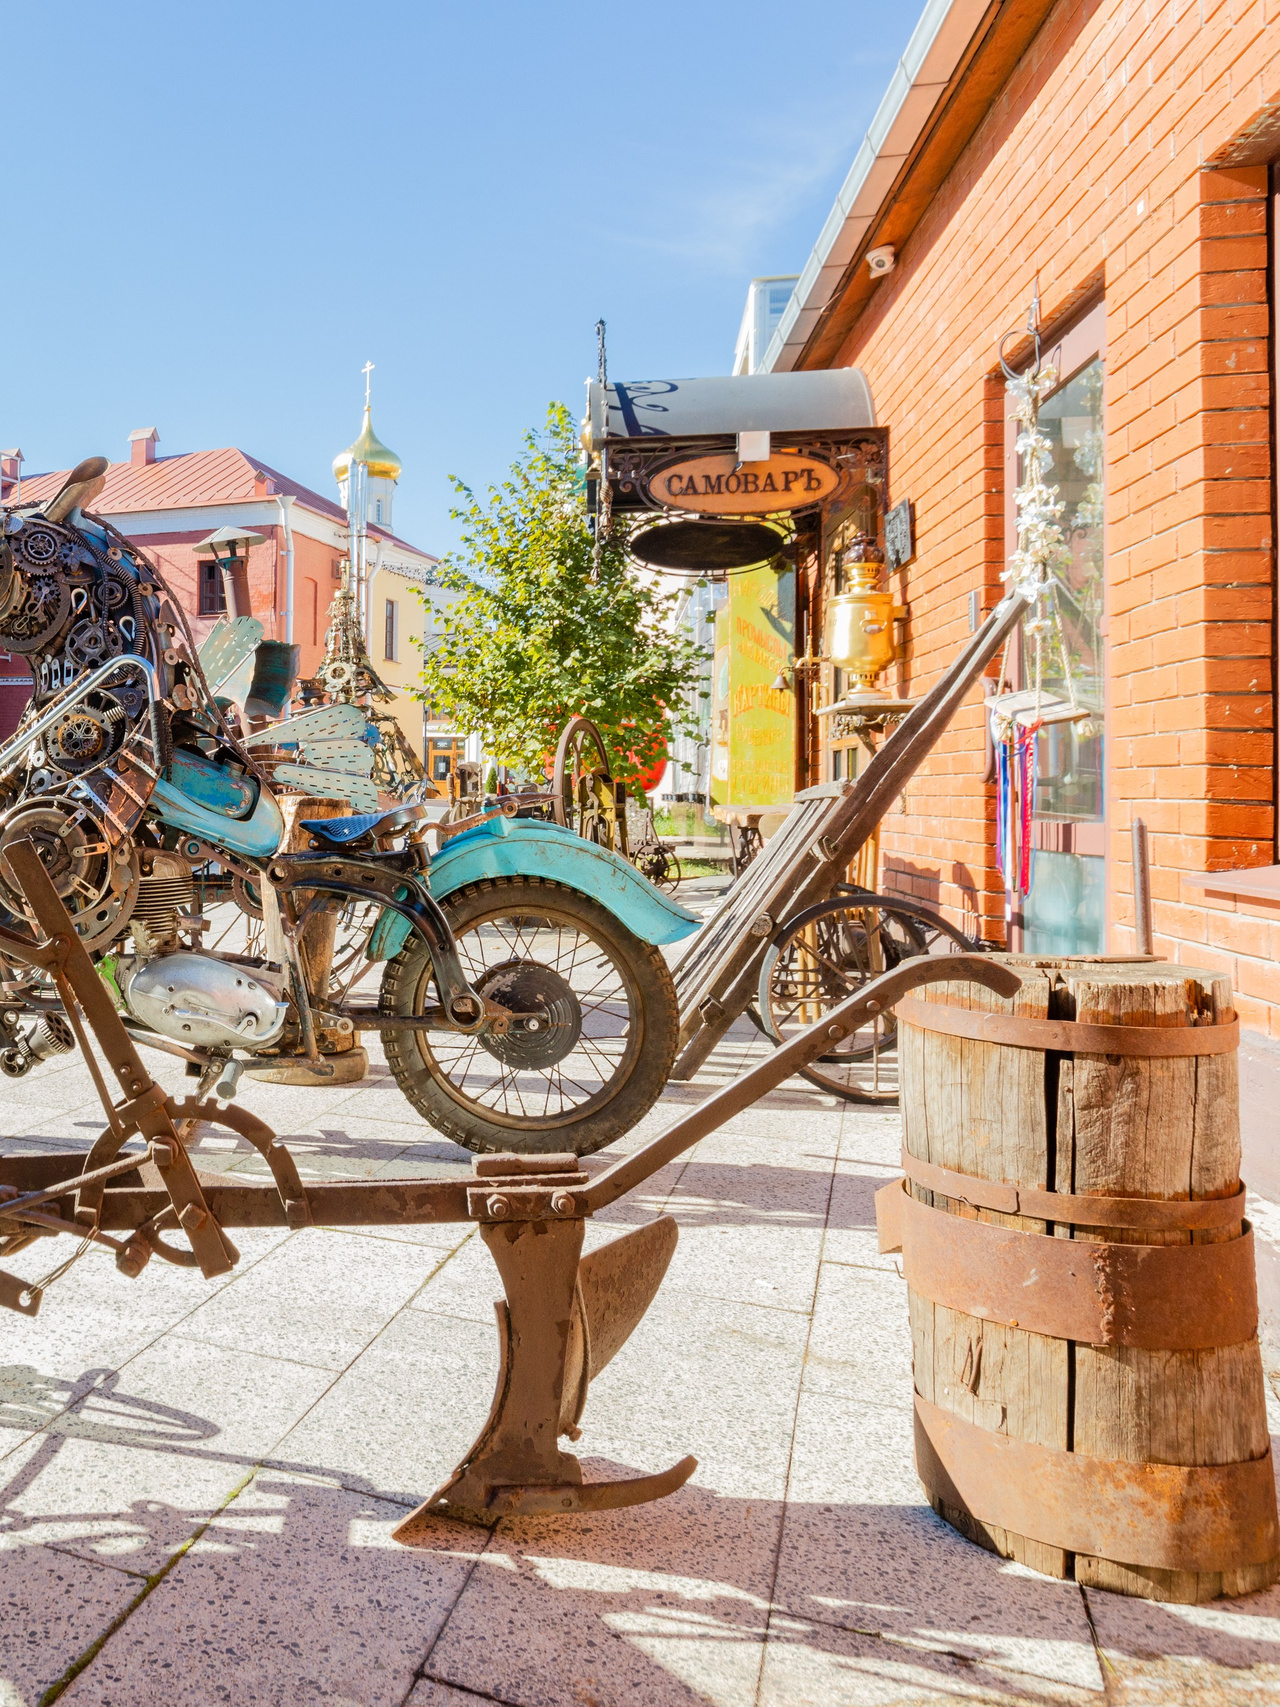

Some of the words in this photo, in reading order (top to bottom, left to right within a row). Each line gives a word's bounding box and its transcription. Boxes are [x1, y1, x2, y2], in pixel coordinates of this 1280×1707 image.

[666, 468, 822, 497] САМОВАРЪ
[736, 616, 788, 662] ПРОМЫСЛЫ
[733, 683, 791, 719] КАРТИНЫ
